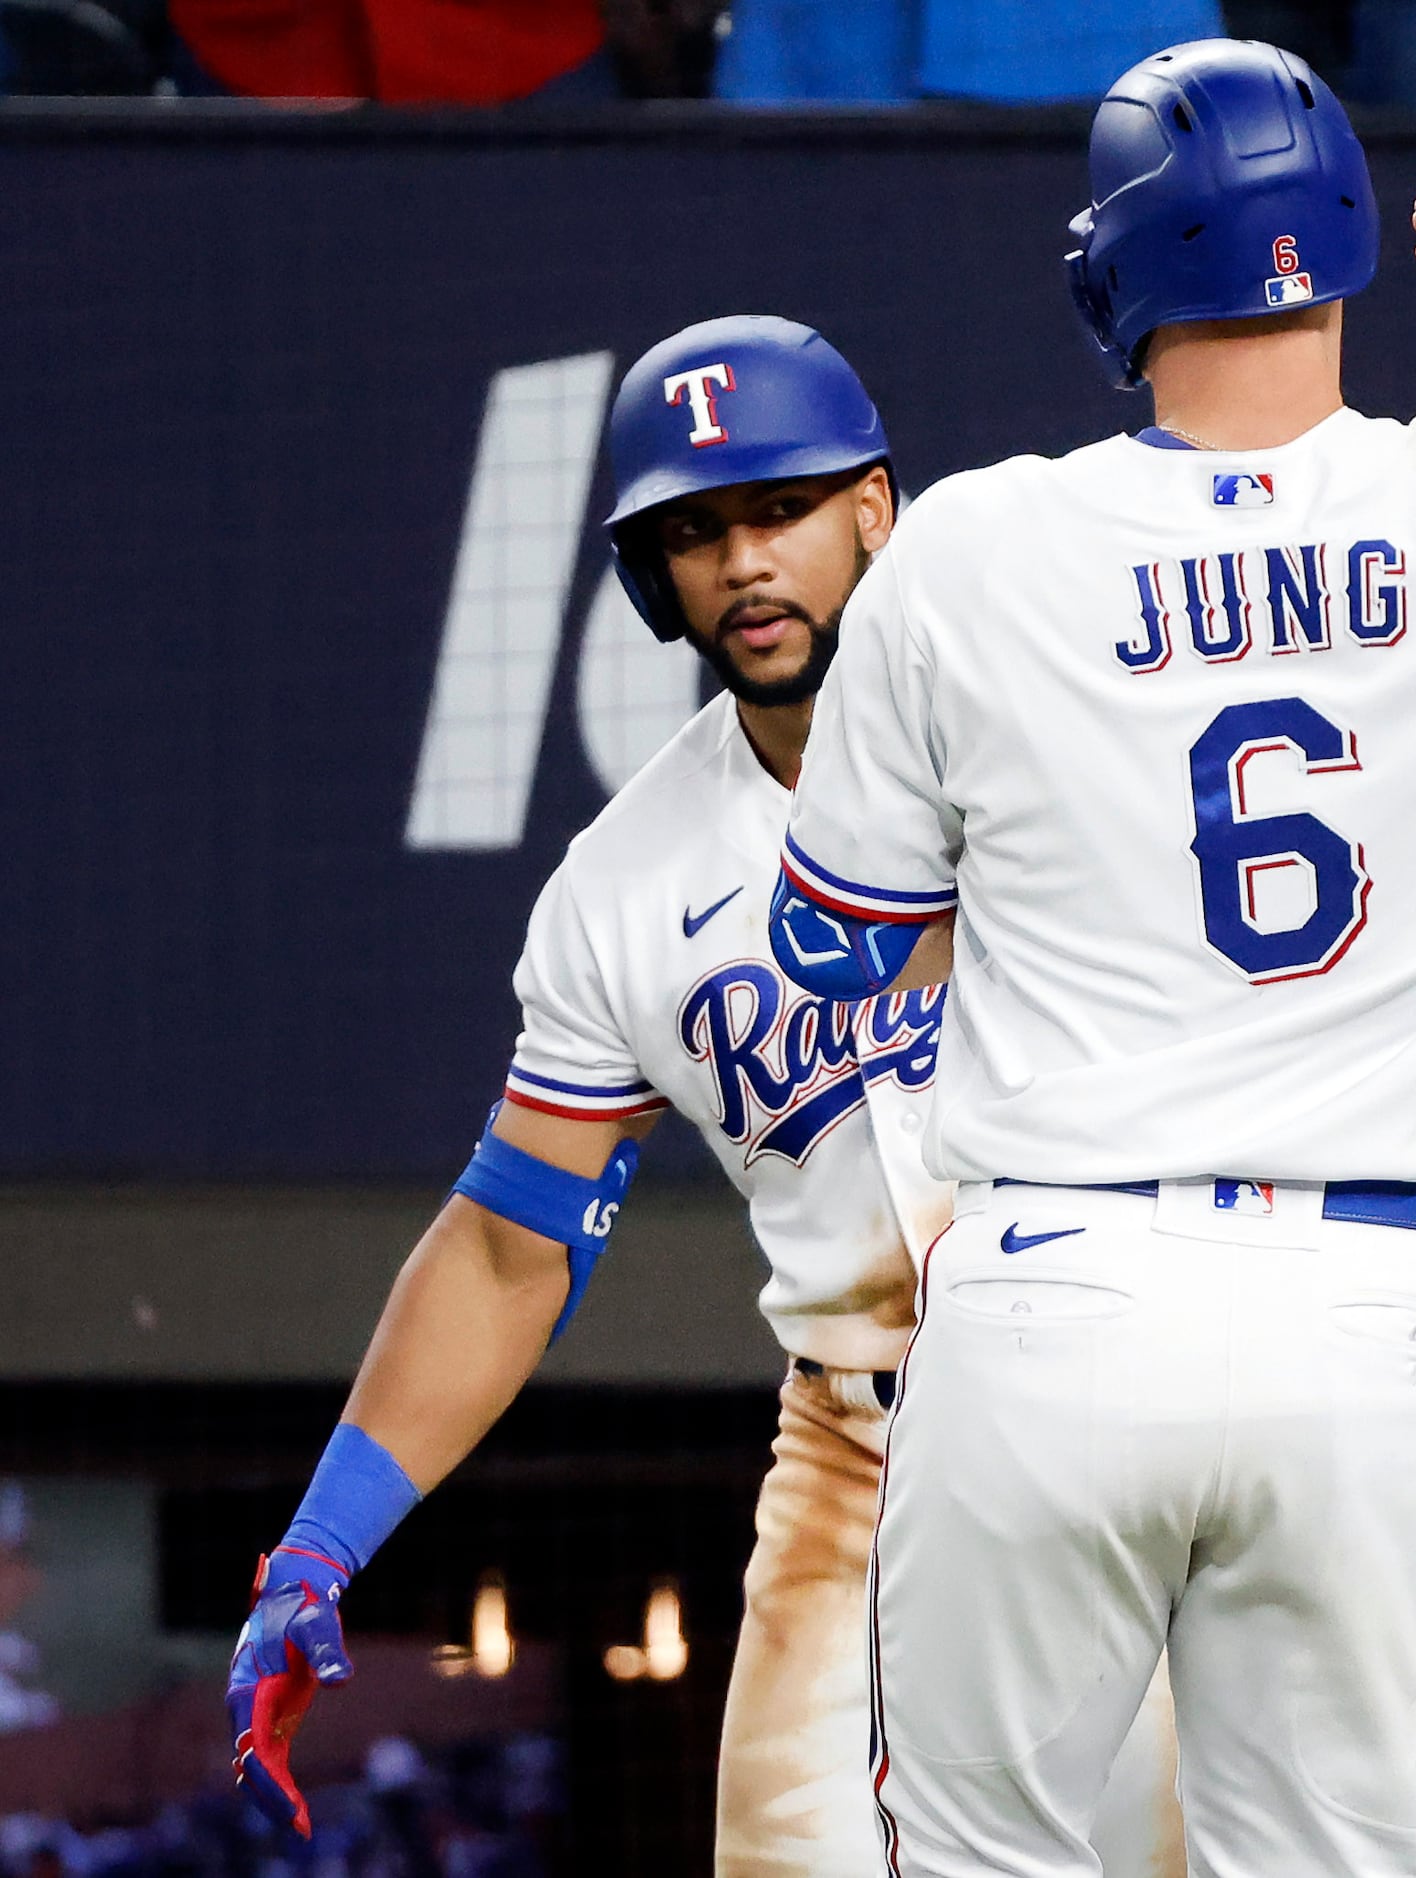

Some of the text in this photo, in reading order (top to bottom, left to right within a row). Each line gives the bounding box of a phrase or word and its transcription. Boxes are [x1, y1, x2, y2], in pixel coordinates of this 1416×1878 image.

[1272, 234, 1299, 275] 6
[663, 362, 736, 447] T
[1114, 538, 1408, 675] JUNG
[1187, 697, 1371, 984] 6
